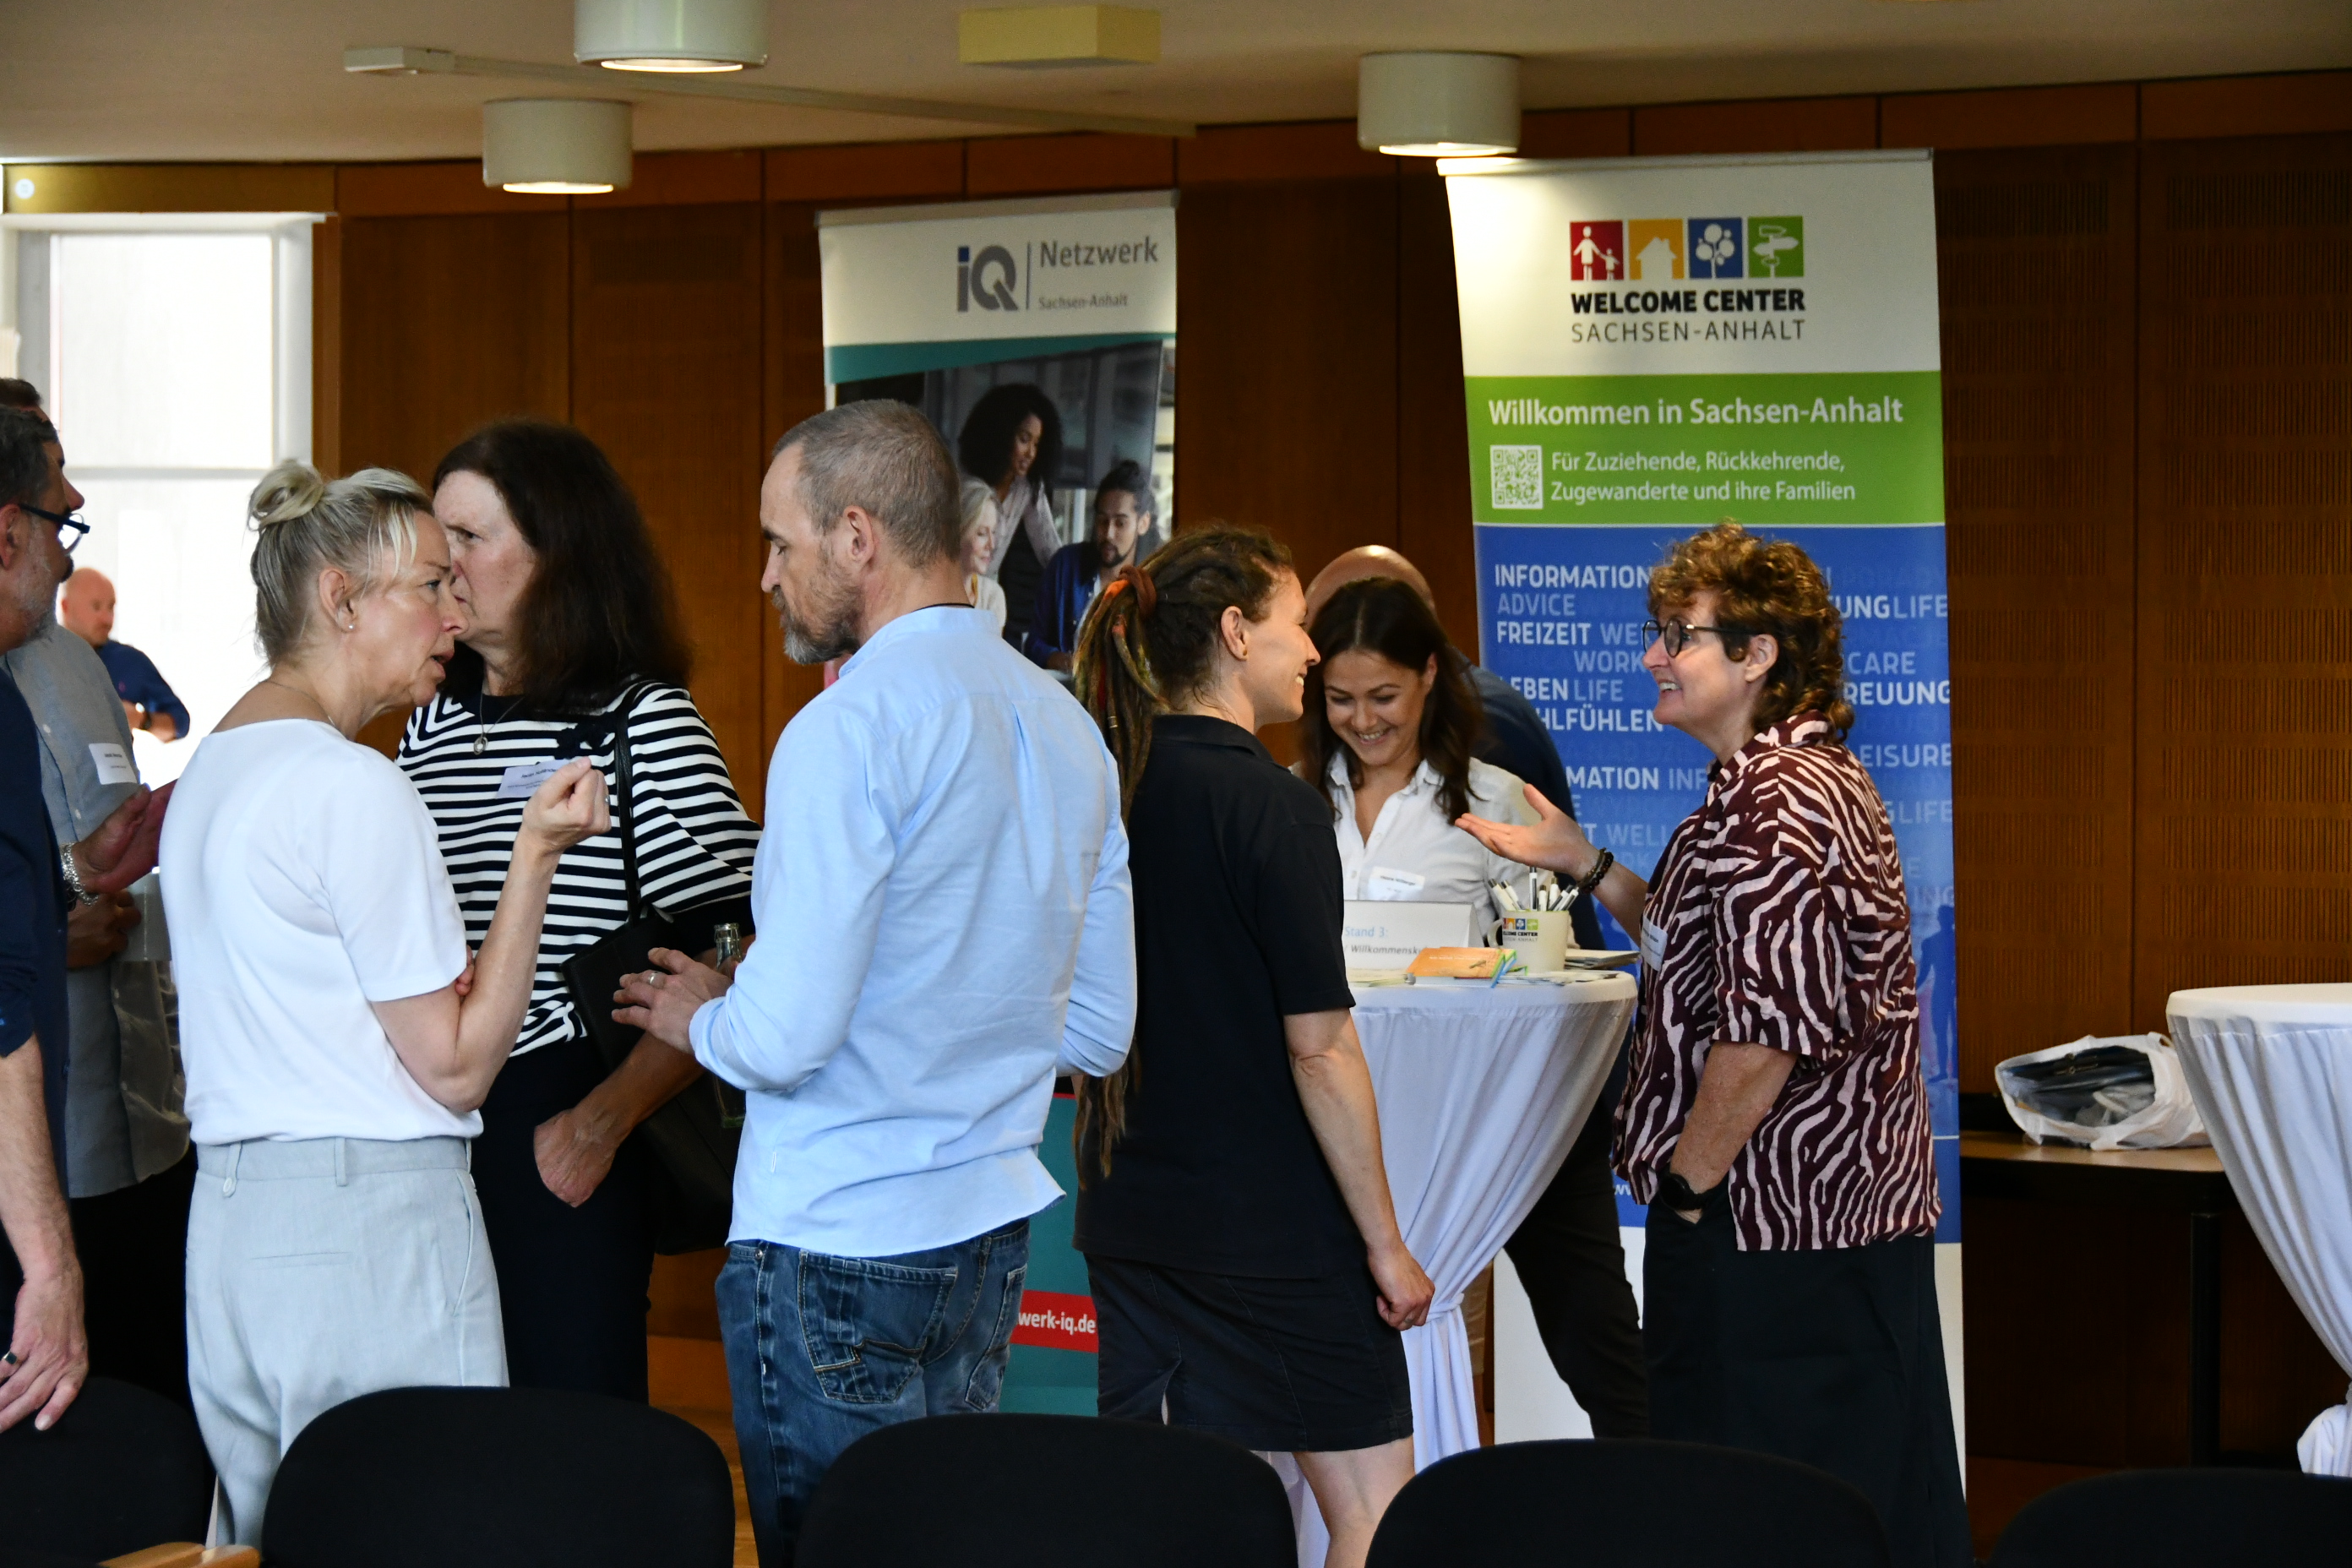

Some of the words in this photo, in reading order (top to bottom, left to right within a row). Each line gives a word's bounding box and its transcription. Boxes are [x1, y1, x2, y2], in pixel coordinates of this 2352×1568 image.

[1040, 237, 1158, 268] Netzwerk
[1038, 293, 1129, 310] Sachsen-Anhalt
[1571, 291, 1696, 313] WELCOME
[1703, 289, 1805, 313] CENTER
[1571, 319, 1805, 343] SACHSEN-ANHALT
[1489, 399, 1649, 426] Willkommen
[1658, 399, 1683, 424] in
[1690, 395, 1903, 425] Sachsen-Anhalt
[1551, 451, 1580, 471] Für
[1584, 451, 1701, 473] Zuziehende,
[1706, 450, 1845, 472] Rückkehrende,
[1550, 481, 1689, 505] Zugewanderte
[1693, 480, 1730, 501] und
[1734, 481, 1771, 501] ihre
[1775, 481, 1856, 501] Familien
[1494, 564, 1650, 589] INFORMATION
[1497, 592, 1576, 617] ADVICE
[1497, 621, 1592, 645] FREIZEIT
[1573, 649, 1647, 673] WORK
[1848, 651, 1917, 675] CARE
[1573, 678, 1624, 703] LIFE
[1344, 926, 1375, 937] Stand
